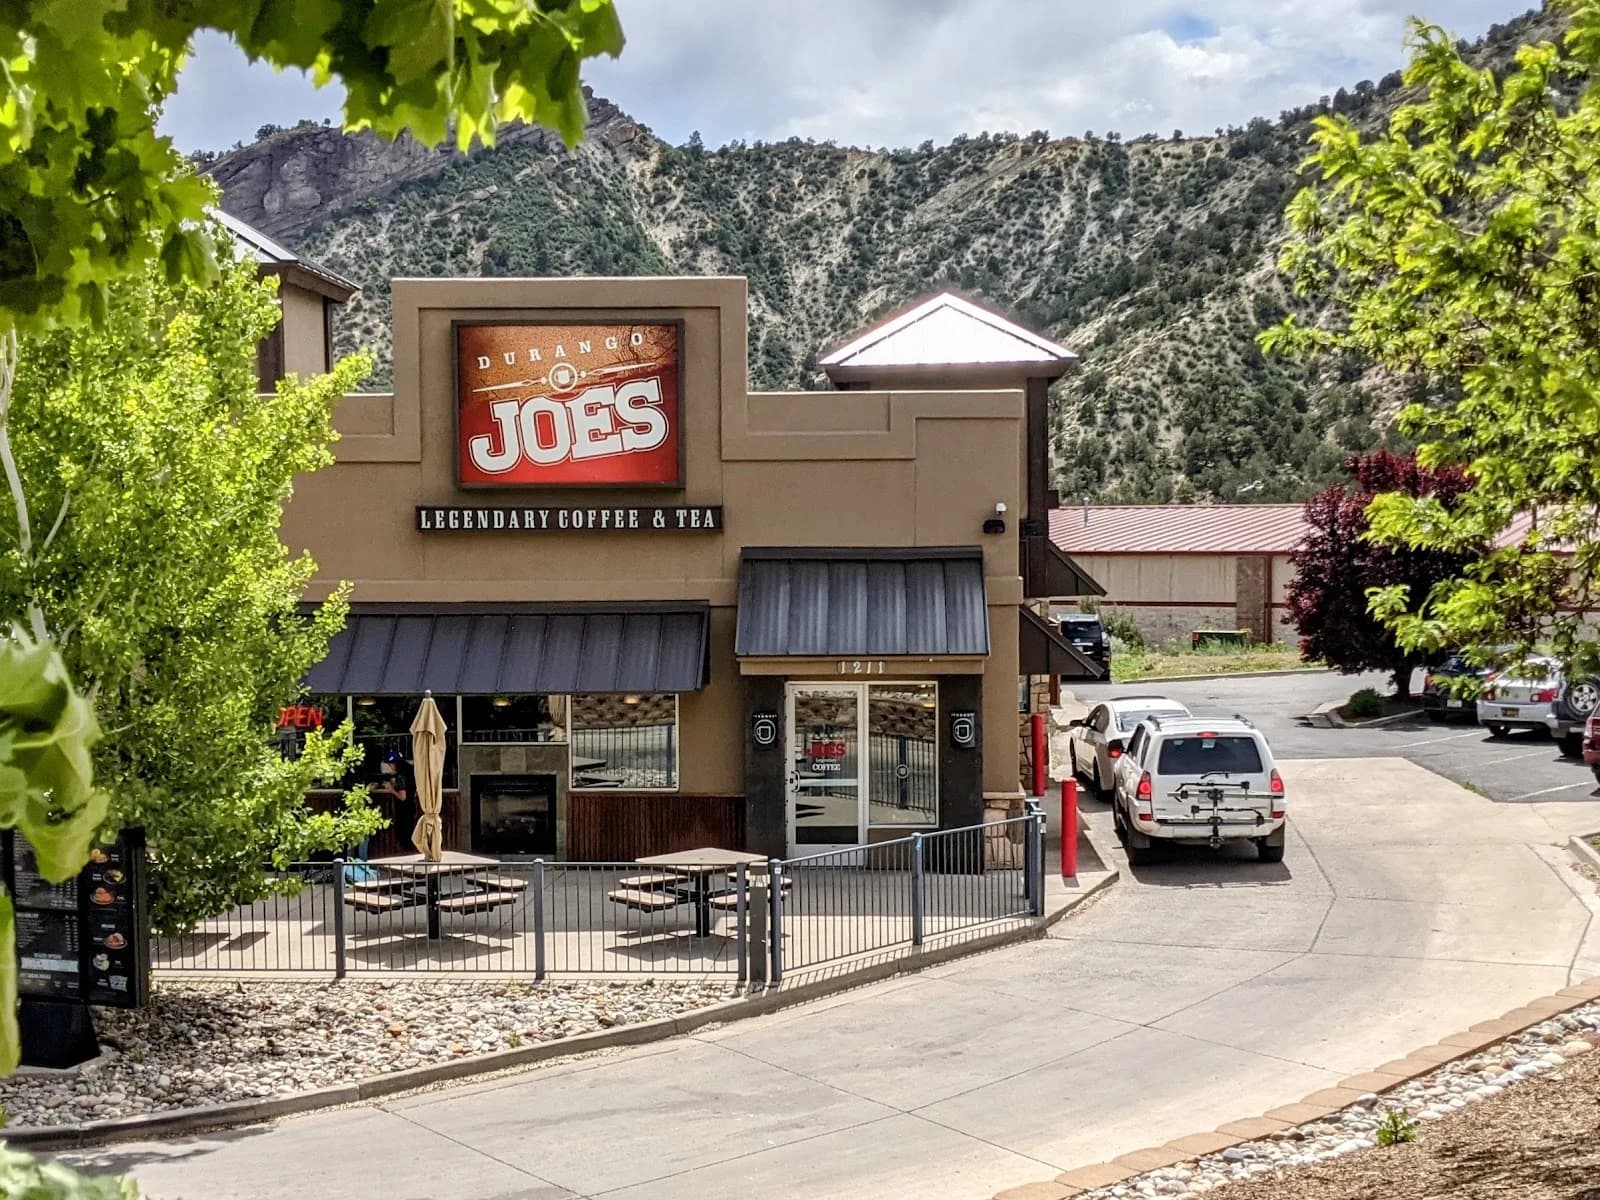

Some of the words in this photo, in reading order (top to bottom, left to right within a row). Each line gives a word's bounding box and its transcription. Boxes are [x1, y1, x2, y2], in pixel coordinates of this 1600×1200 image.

[477, 332, 644, 370] DURANGO
[468, 376, 669, 474] JOES
[420, 509, 550, 529] LEGENDARY
[558, 509, 639, 529] COFFEE
[653, 509, 666, 528] &
[676, 509, 714, 528] TEA
[840, 661, 883, 674] 1211
